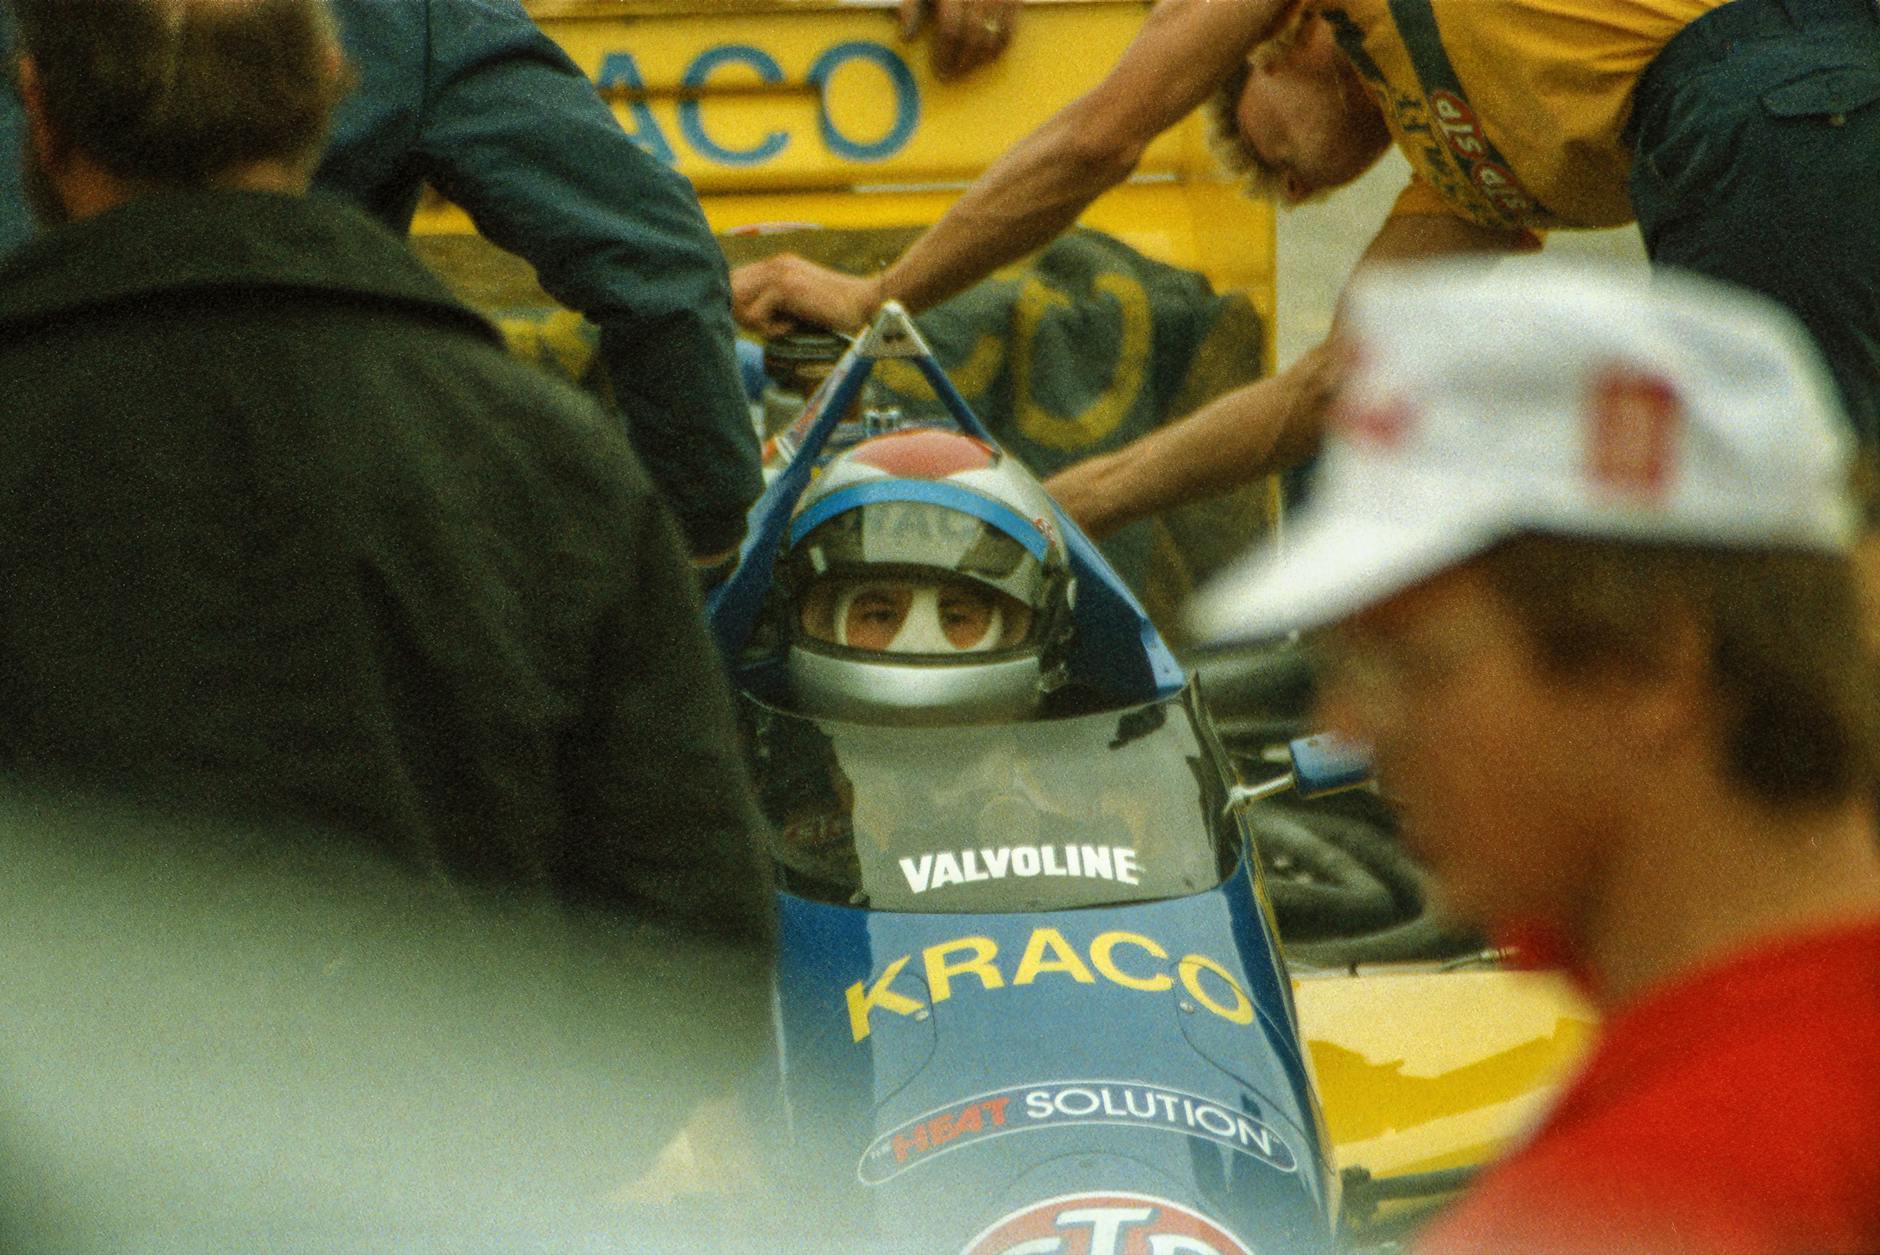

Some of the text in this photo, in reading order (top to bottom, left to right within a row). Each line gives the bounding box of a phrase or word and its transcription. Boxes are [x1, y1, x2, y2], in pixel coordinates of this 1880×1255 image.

[1436, 99, 1484, 154] STP
[899, 845, 1140, 894] VALVOLINE
[845, 928, 1255, 1043] KRACO
[893, 1089, 1271, 1162] HEAT SOLUTION
